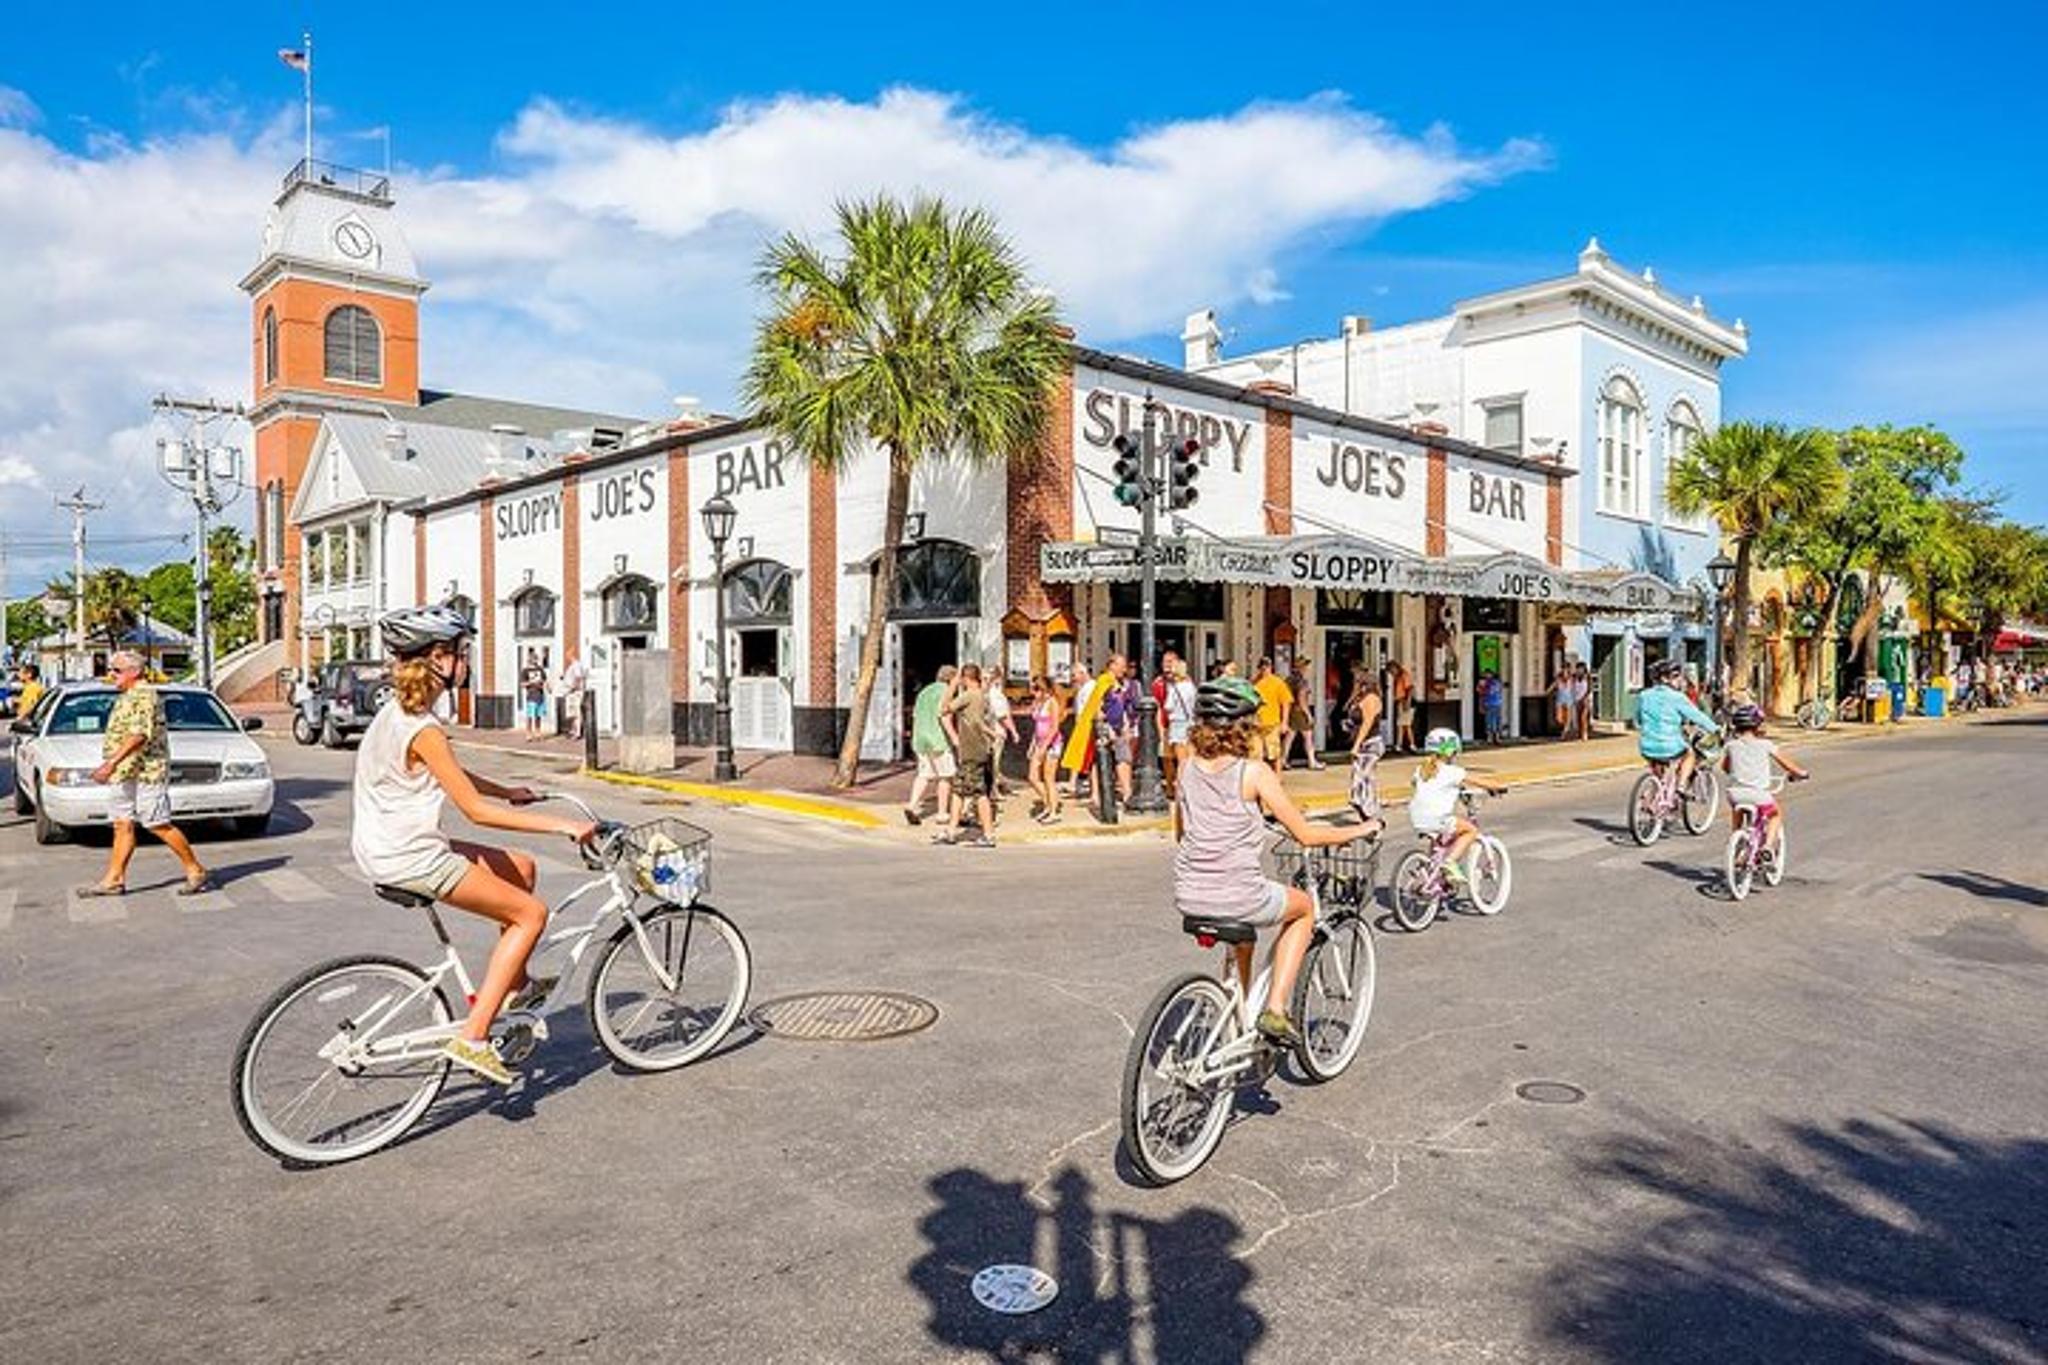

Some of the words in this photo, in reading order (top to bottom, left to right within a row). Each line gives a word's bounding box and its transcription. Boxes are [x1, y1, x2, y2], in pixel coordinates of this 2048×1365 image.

[497, 494, 562, 540] SLOPPY
[591, 469, 656, 521] JOE'S
[715, 440, 785, 497] BAR
[1316, 440, 1407, 499] JOE'S
[1468, 471, 1526, 521] BAR
[1290, 552, 1393, 583] SLOPPY
[1499, 573, 1551, 598] JOE'S
[1626, 585, 1656, 606] BAR
